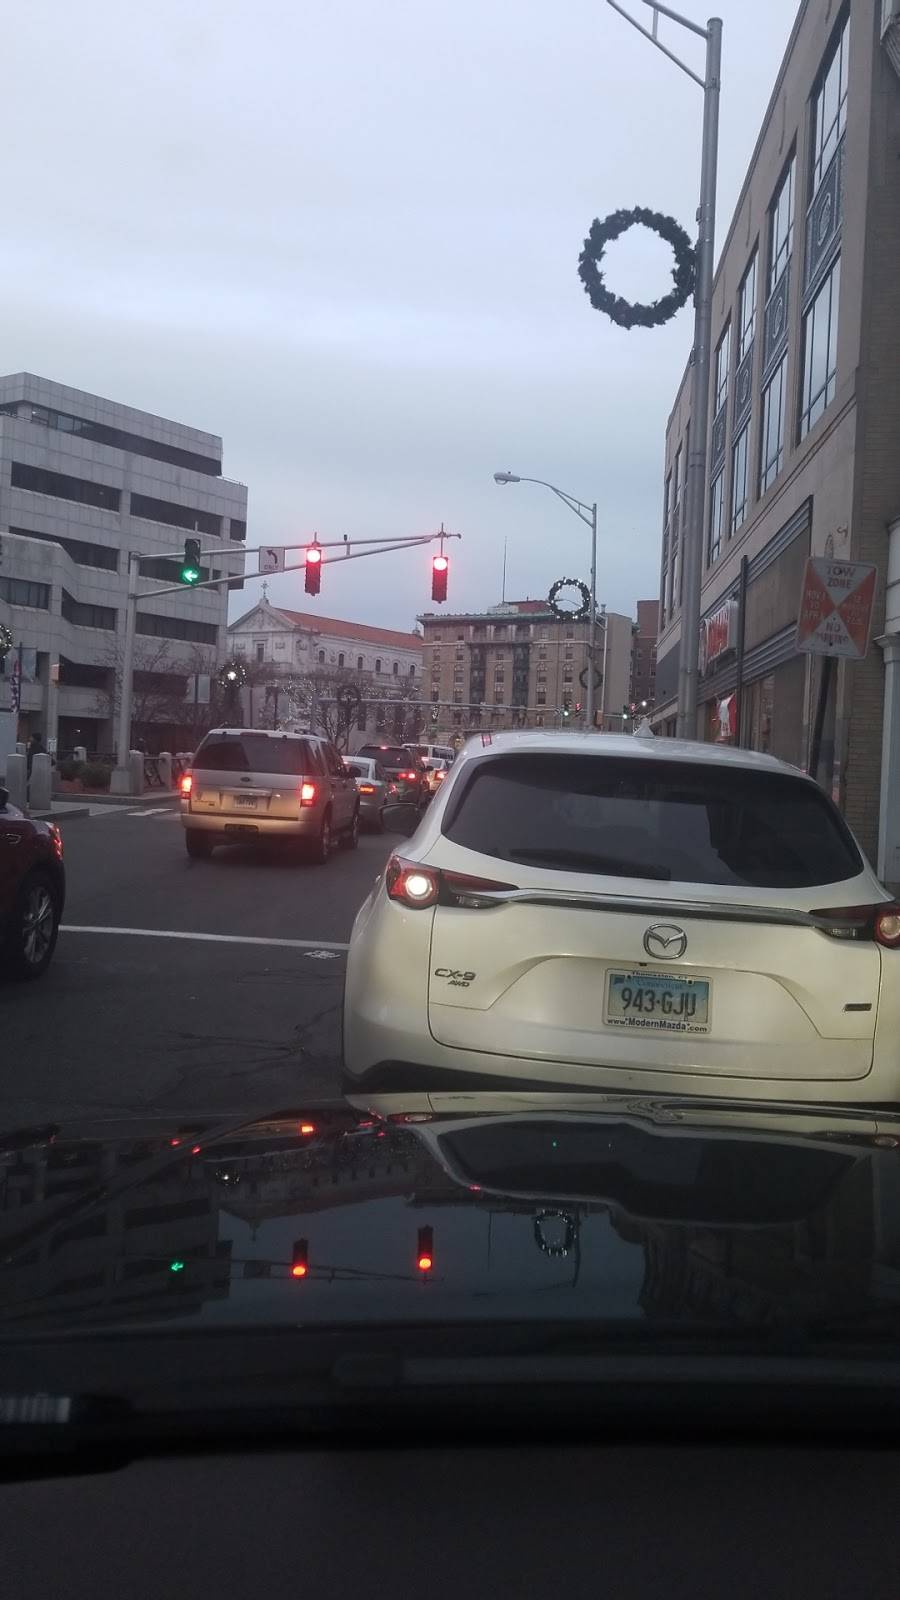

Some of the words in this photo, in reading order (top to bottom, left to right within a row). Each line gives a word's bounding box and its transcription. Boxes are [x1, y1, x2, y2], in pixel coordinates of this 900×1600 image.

[827, 566, 856, 577] TOW
[827, 577, 853, 589] ZONE
[826, 622, 841, 633] NO
[434, 968, 476, 981] CX-9
